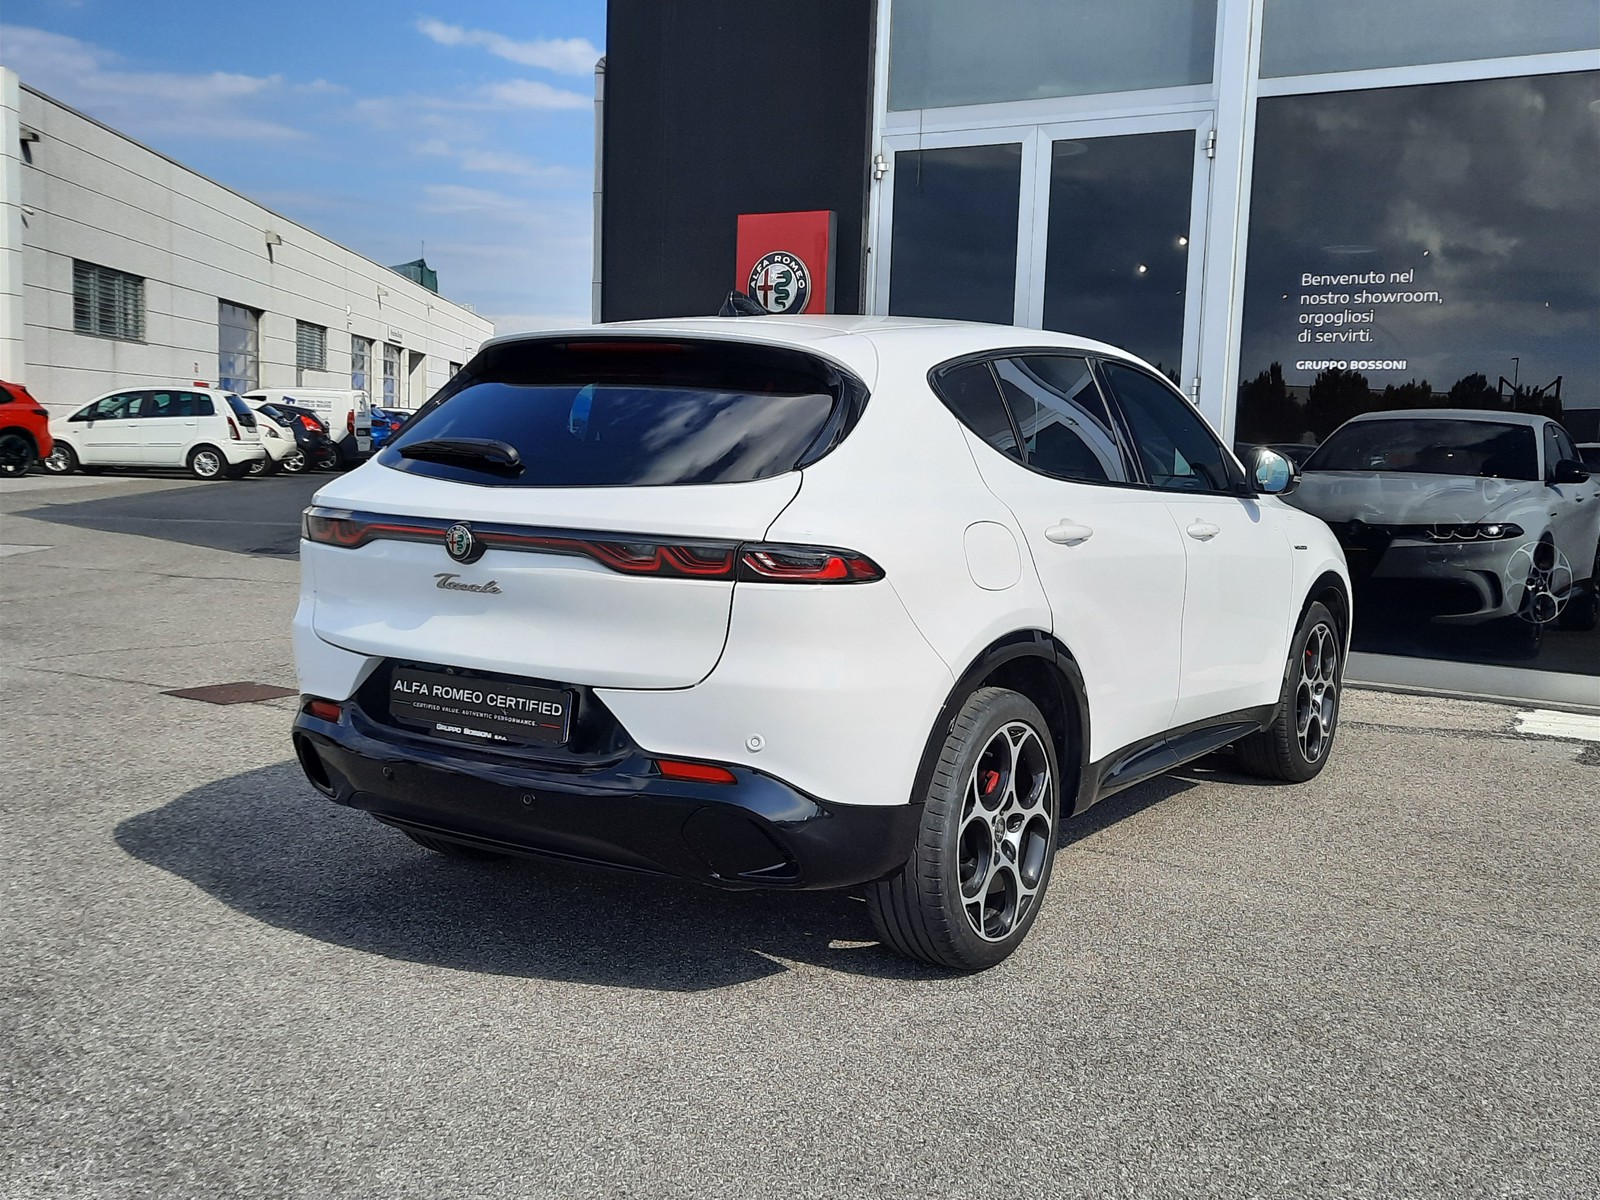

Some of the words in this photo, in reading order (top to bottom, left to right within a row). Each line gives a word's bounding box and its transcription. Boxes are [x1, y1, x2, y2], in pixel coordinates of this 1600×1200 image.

[751, 260, 769, 288] ALFA
[774, 255, 805, 288] ROMEO
[1301, 271, 1386, 286] Benvenuto
[1389, 268, 1414, 283] nel
[1300, 291, 1350, 305] nostro
[1353, 290, 1443, 304] showroom,
[1298, 309, 1374, 327] orgogliosi
[1297, 329, 1311, 342] di
[1314, 328, 1374, 342] servirti.
[1295, 360, 1347, 370] GRUPPO
[1350, 360, 1407, 370] BOSSONI
[393, 679, 429, 696] ALFA
[432, 685, 483, 704] ROMEO
[486, 693, 563, 717] CERTIFIED
[412, 701, 441, 711] CERTIFIED
[461, 709, 493, 720] AUTHENTIC
[493, 714, 538, 727] PERFORMANCE.
